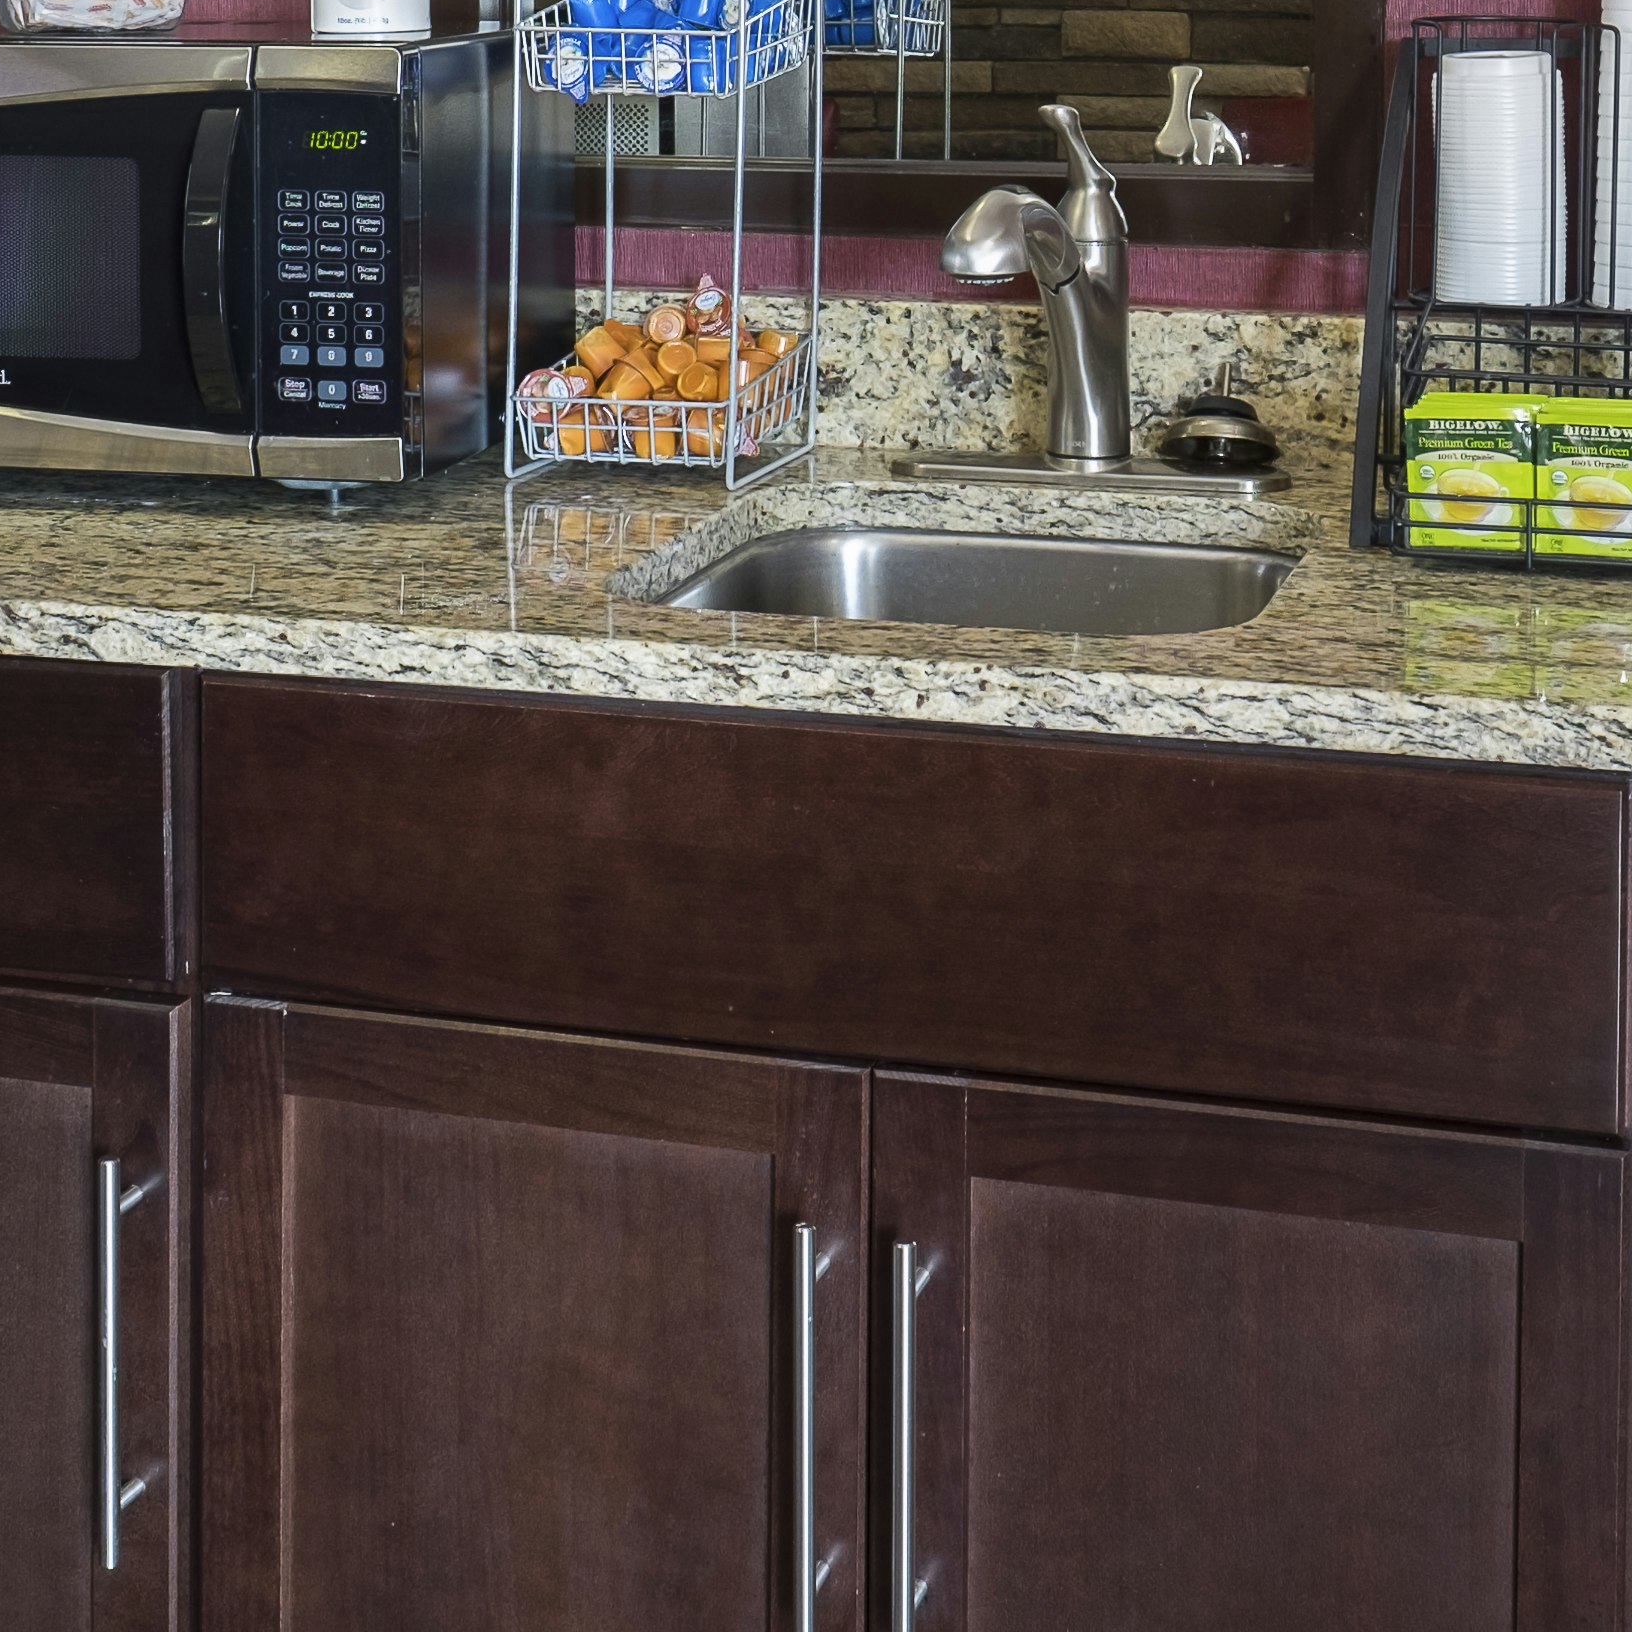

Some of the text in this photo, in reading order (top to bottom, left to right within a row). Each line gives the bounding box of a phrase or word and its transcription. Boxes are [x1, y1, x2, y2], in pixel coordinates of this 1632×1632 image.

[309, 131, 359, 149] 10:00
[291, 305, 297, 315] 1
[328, 306, 335, 316] 2
[365, 307, 372, 318] 3
[291, 327, 298, 337] 4
[328, 328, 335, 338] 5
[365, 330, 373, 340] 6
[291, 349, 298, 359] 7
[328, 350, 335, 360] 8
[365, 351, 373, 362] 9
[284, 378, 305, 390] Stop
[359, 382, 379, 392] Start
[1428, 419, 1502, 431] BIGELOW
[1418, 436, 1513, 450] Premium Green Tea
[1551, 441, 1598, 455] Premium
[1599, 444, 1630, 457] Green
[1460, 452, 1495, 462] Organic
[1594, 460, 1630, 469] Organic
